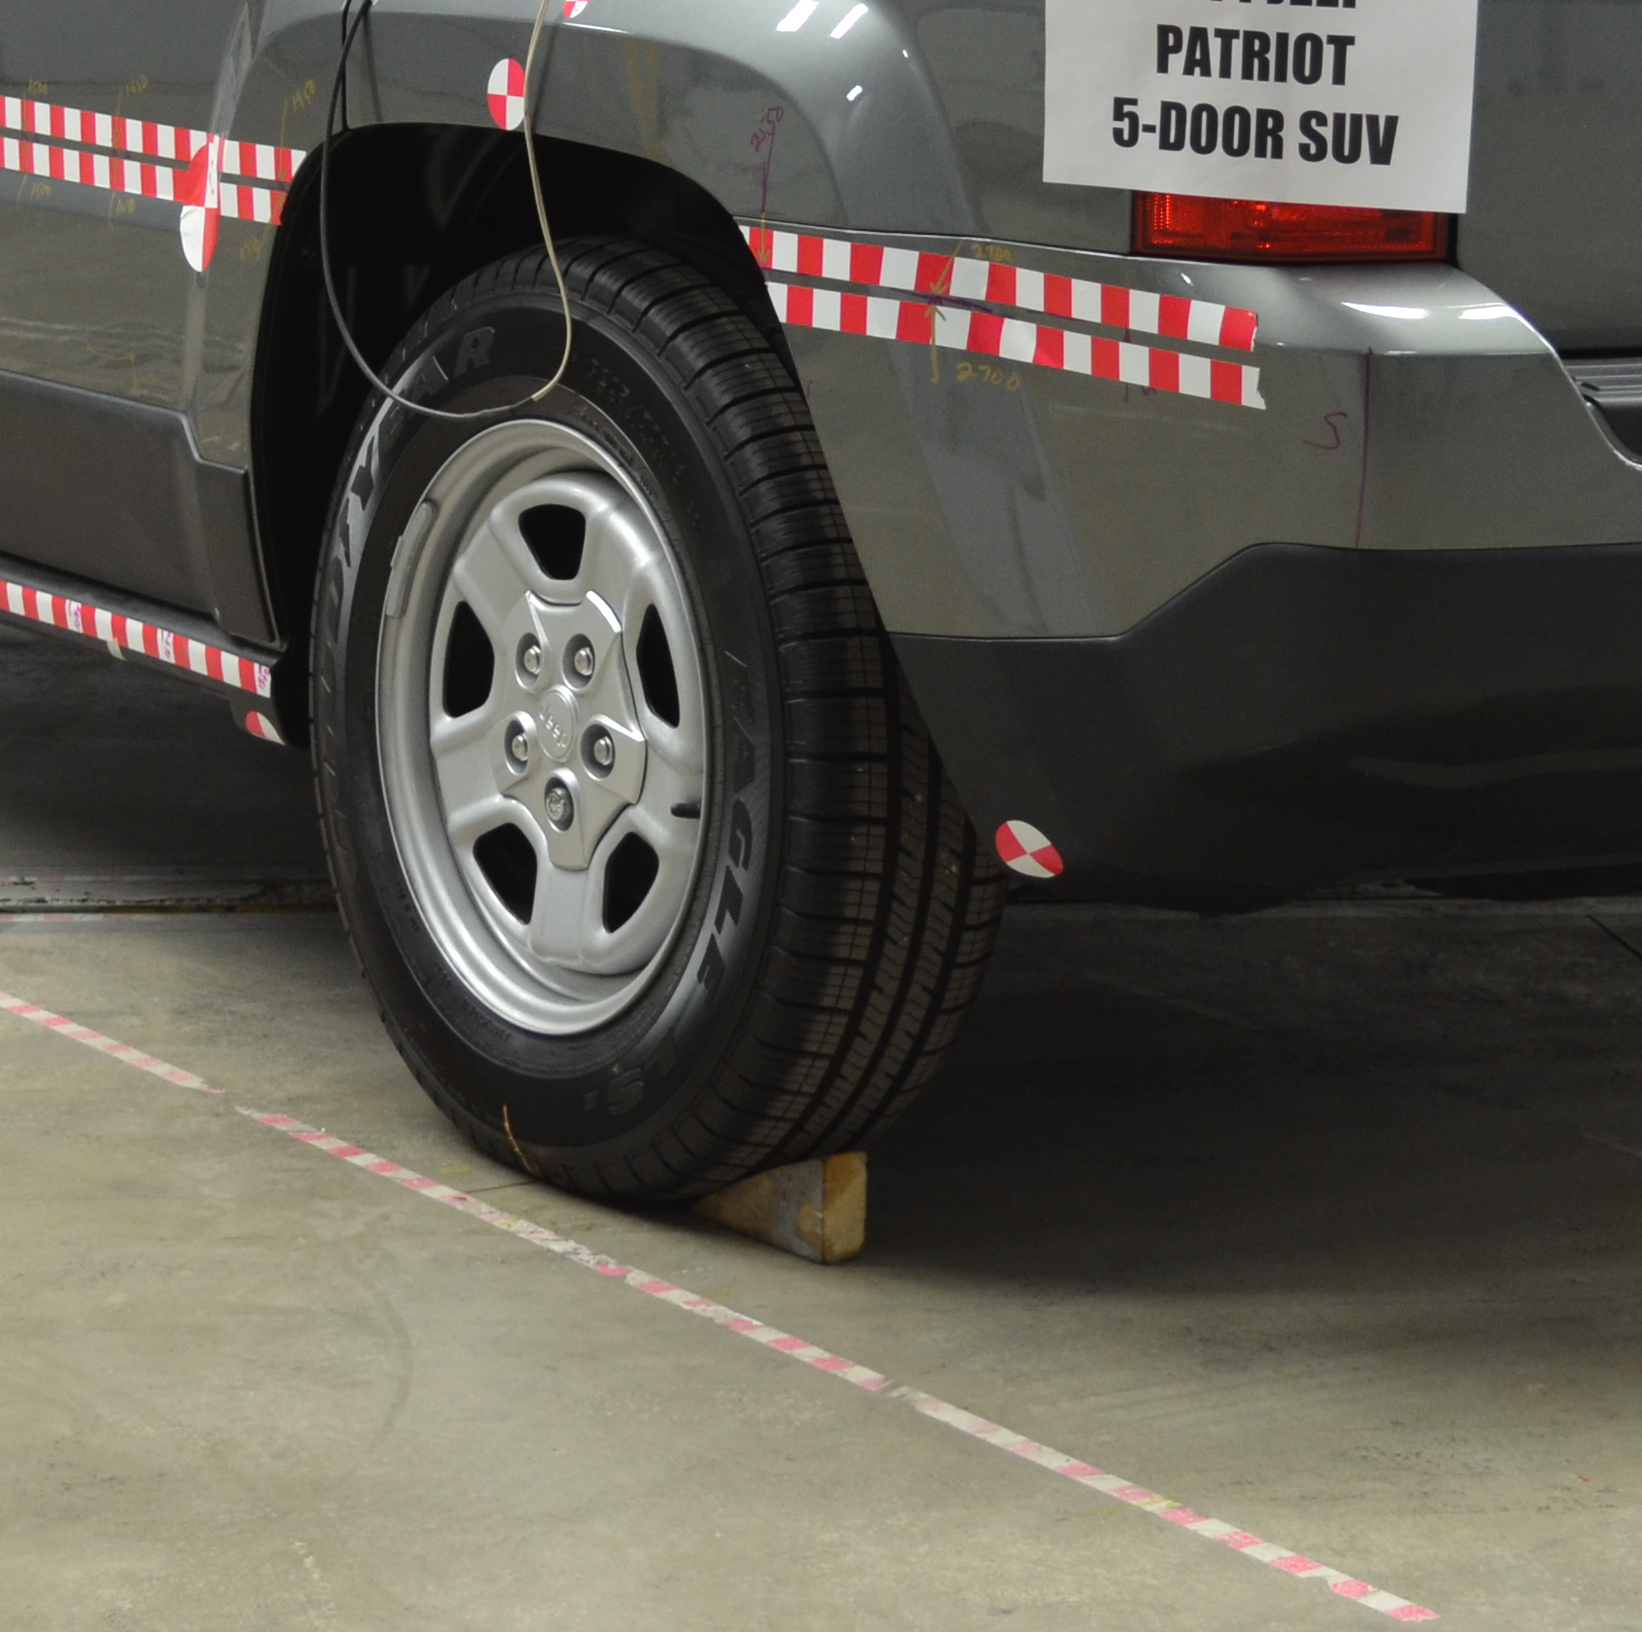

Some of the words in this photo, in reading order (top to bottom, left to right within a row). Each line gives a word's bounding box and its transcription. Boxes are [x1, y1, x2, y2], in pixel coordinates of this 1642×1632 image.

[1155, 23, 1356, 87] PATRIOT
[1111, 96, 1285, 160] 5-DOOR
[1298, 110, 1400, 166] SUV
